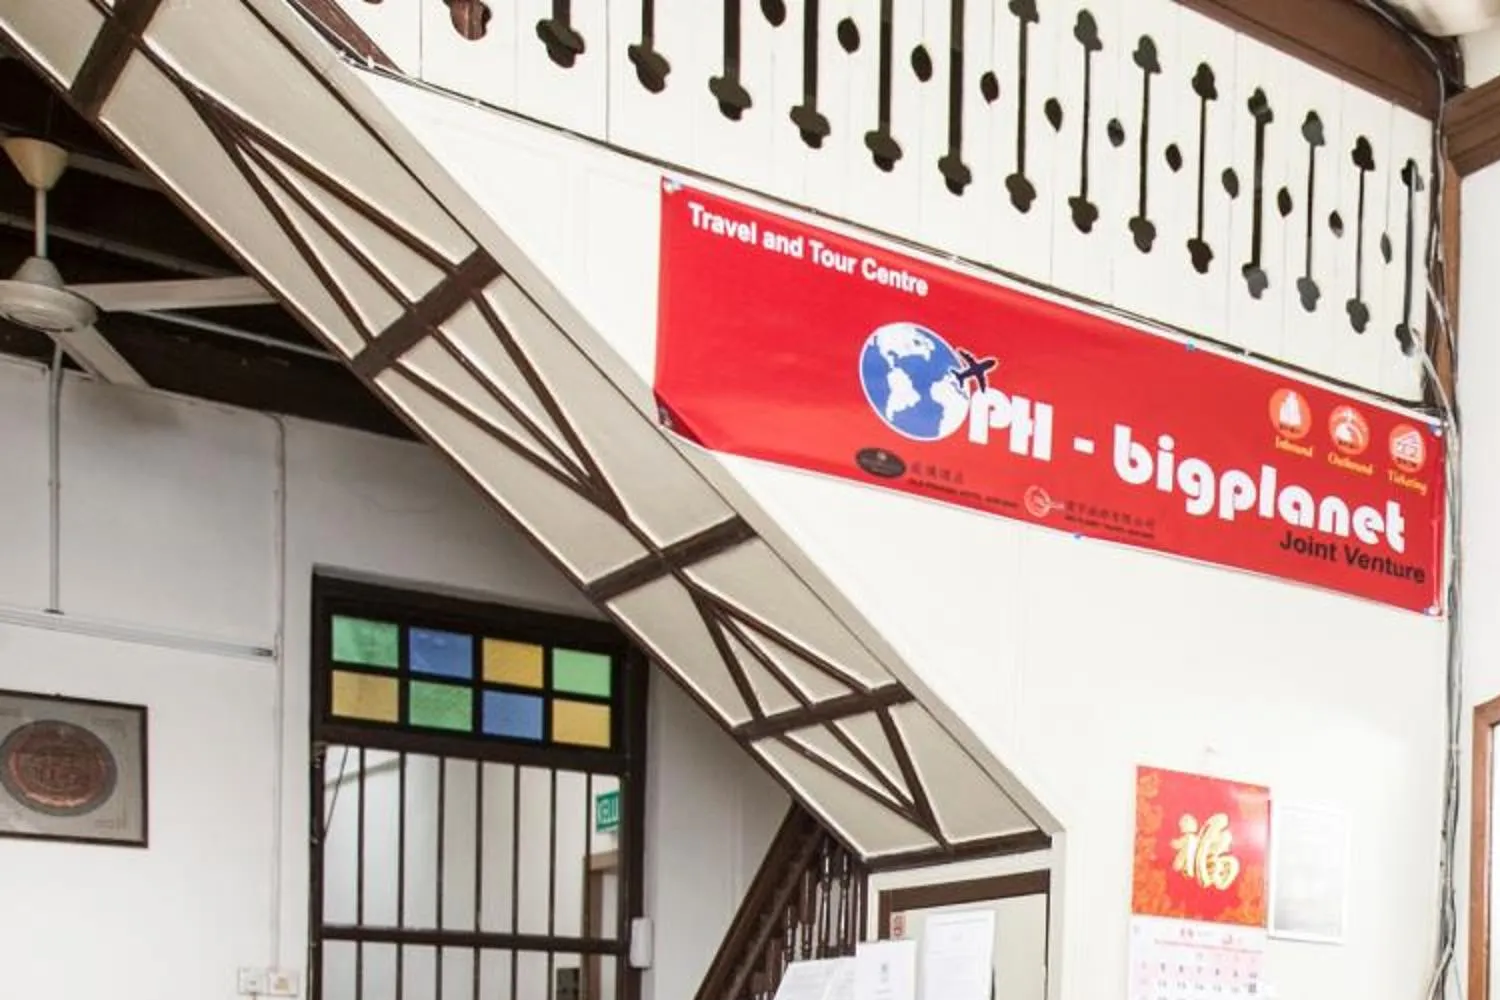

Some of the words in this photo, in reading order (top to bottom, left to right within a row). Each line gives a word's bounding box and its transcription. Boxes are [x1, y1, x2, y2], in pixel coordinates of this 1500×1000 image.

[688, 202, 757, 245] Travel
[762, 230, 805, 259] and
[808, 239, 858, 274] Tour
[861, 257, 929, 297] Centre
[1113, 423, 1406, 554] bigplanet
[1279, 531, 1337, 562] Joint
[1343, 546, 1425, 585] Venture
